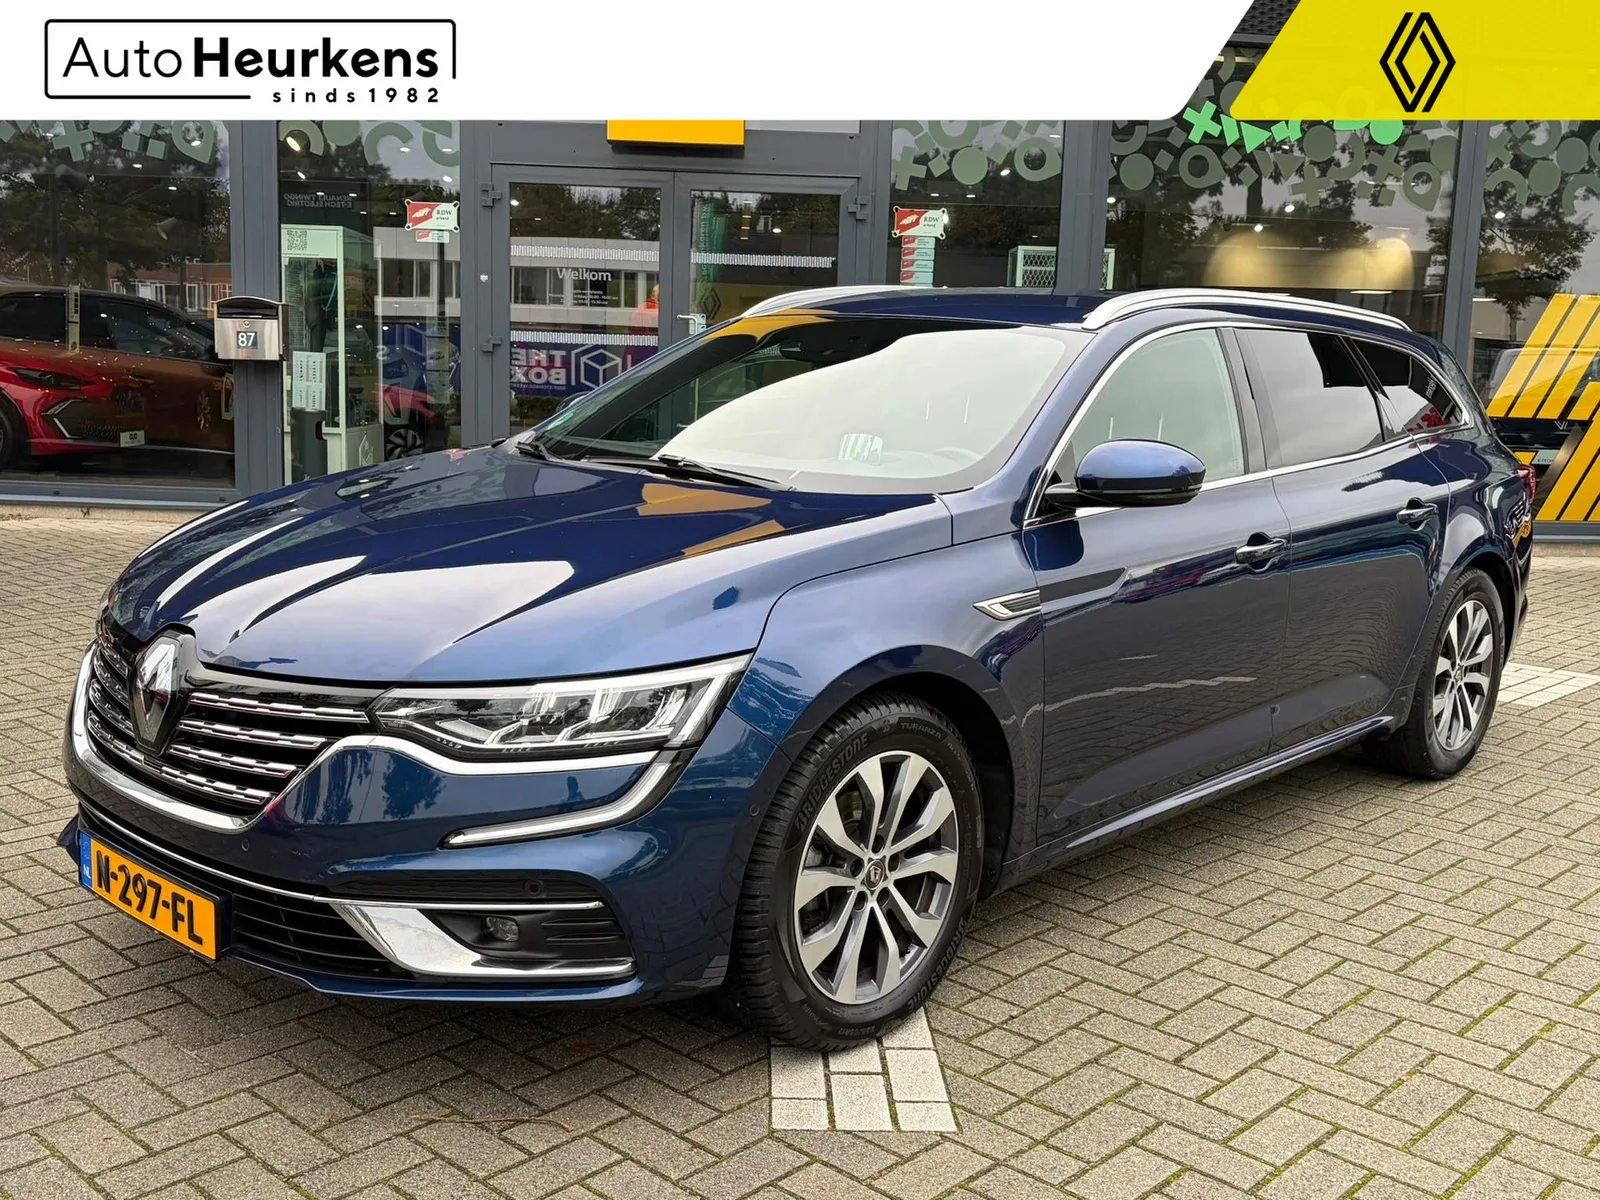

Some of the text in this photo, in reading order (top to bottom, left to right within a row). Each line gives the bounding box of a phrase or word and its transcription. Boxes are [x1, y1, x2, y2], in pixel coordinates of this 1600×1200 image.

[556, 267, 612, 281] Welkom
[238, 332, 256, 347] 87
[900, 722, 942, 740] TURANZA
[793, 733, 869, 833] BRIDGESTONE
[83, 864, 91, 879] NL
[96, 849, 204, 946] N-297-FL
[906, 916, 967, 1012] BRIDGESTONE
